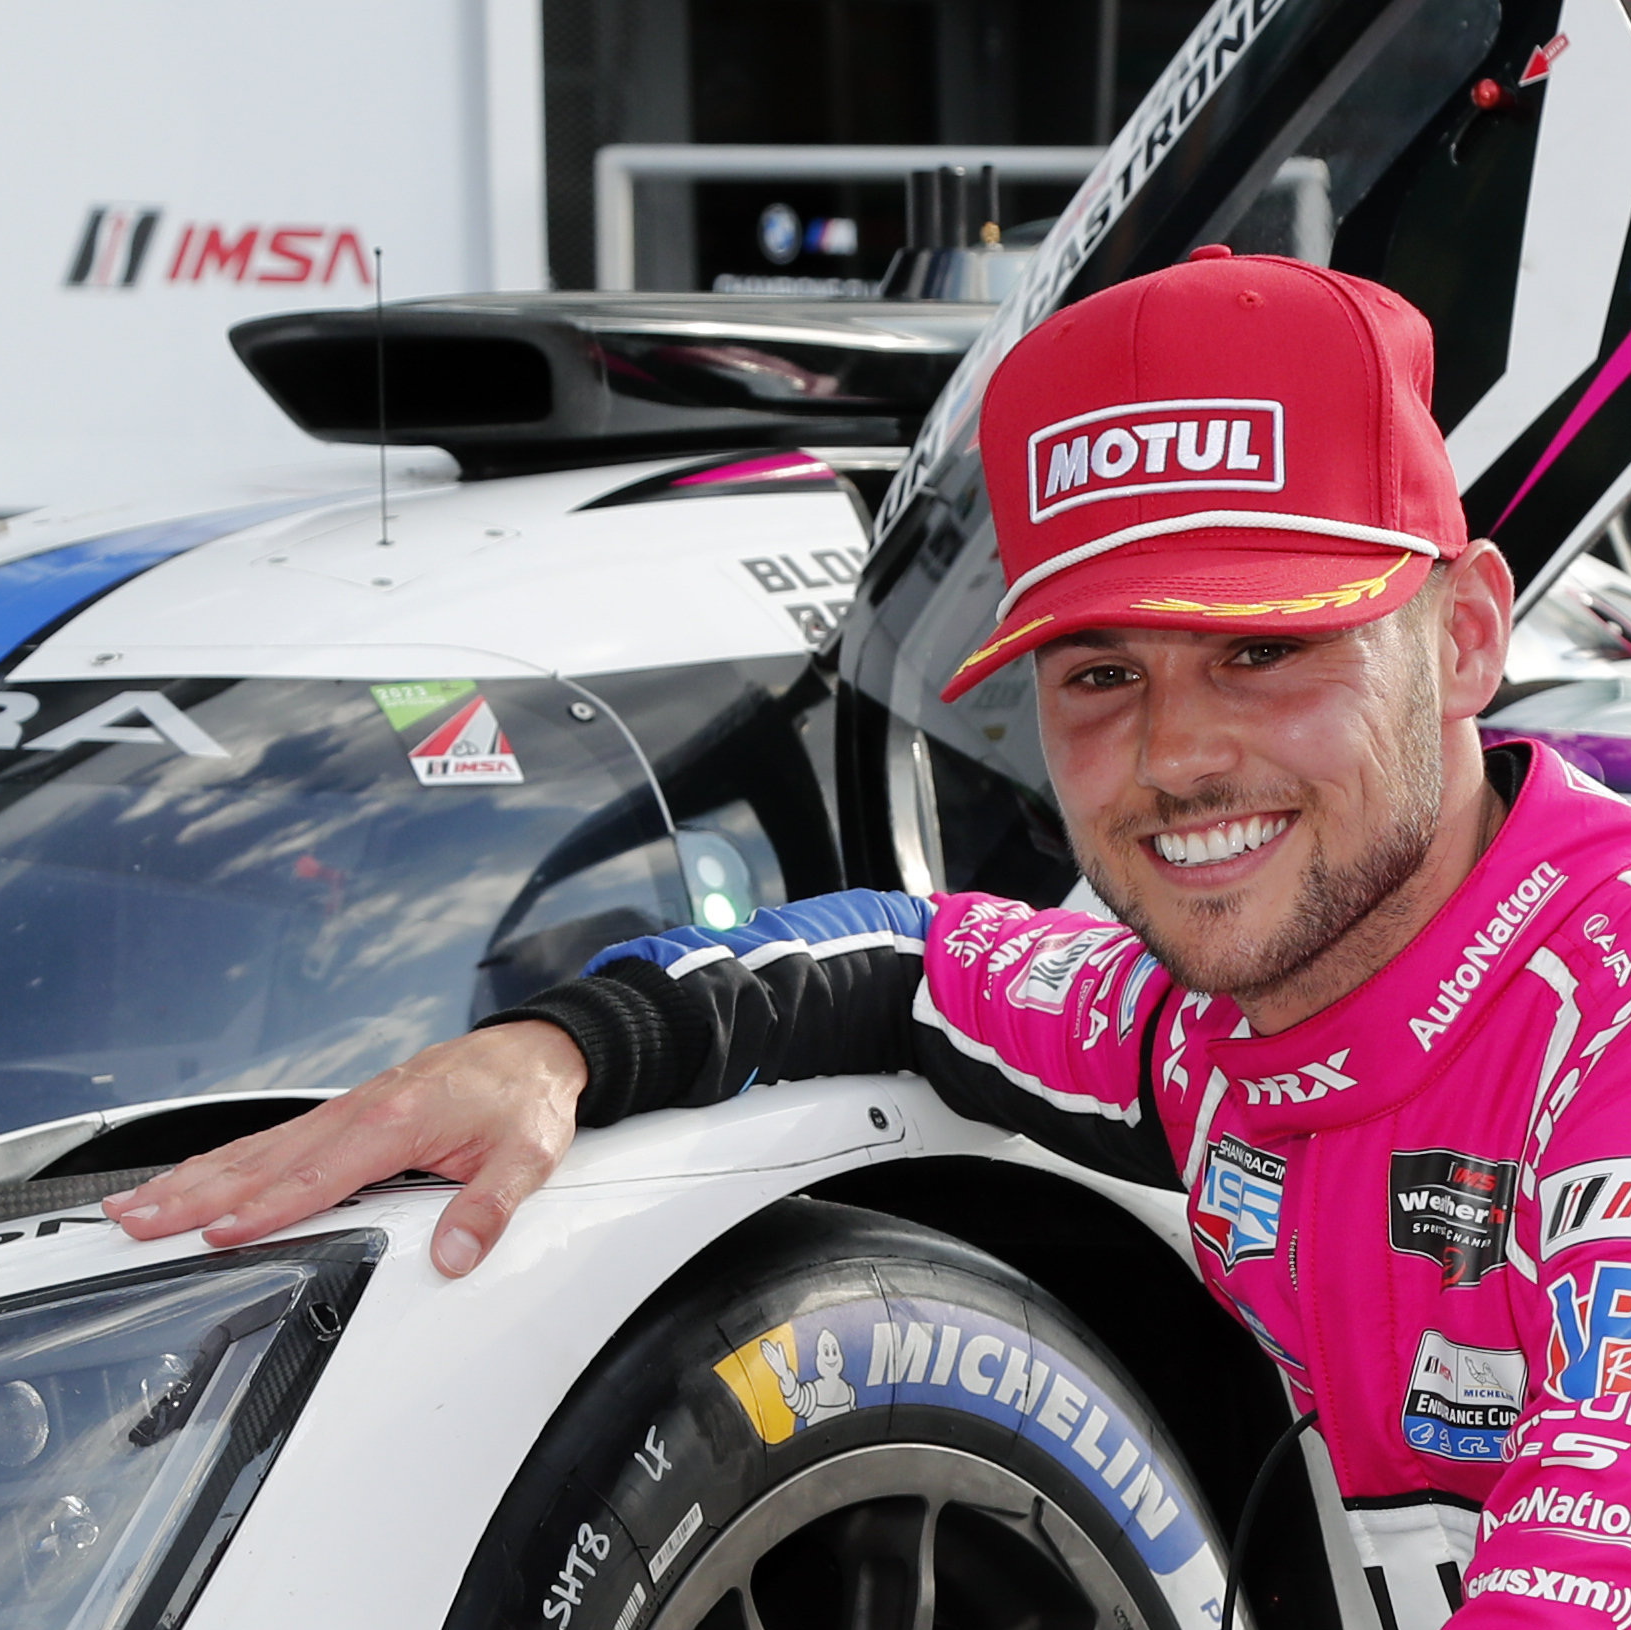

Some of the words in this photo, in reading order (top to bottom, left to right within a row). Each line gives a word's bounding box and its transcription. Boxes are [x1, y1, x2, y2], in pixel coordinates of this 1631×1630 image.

[169, 222, 373, 287] IMSA
[1045, 419, 1262, 499] MOTUL
[454, 760, 513, 774] IMSA
[1408, 861, 1558, 1052] AutoNation
[1236, 1047, 1359, 1106] HRX
[865, 1320, 1182, 1541] MICHELIN
